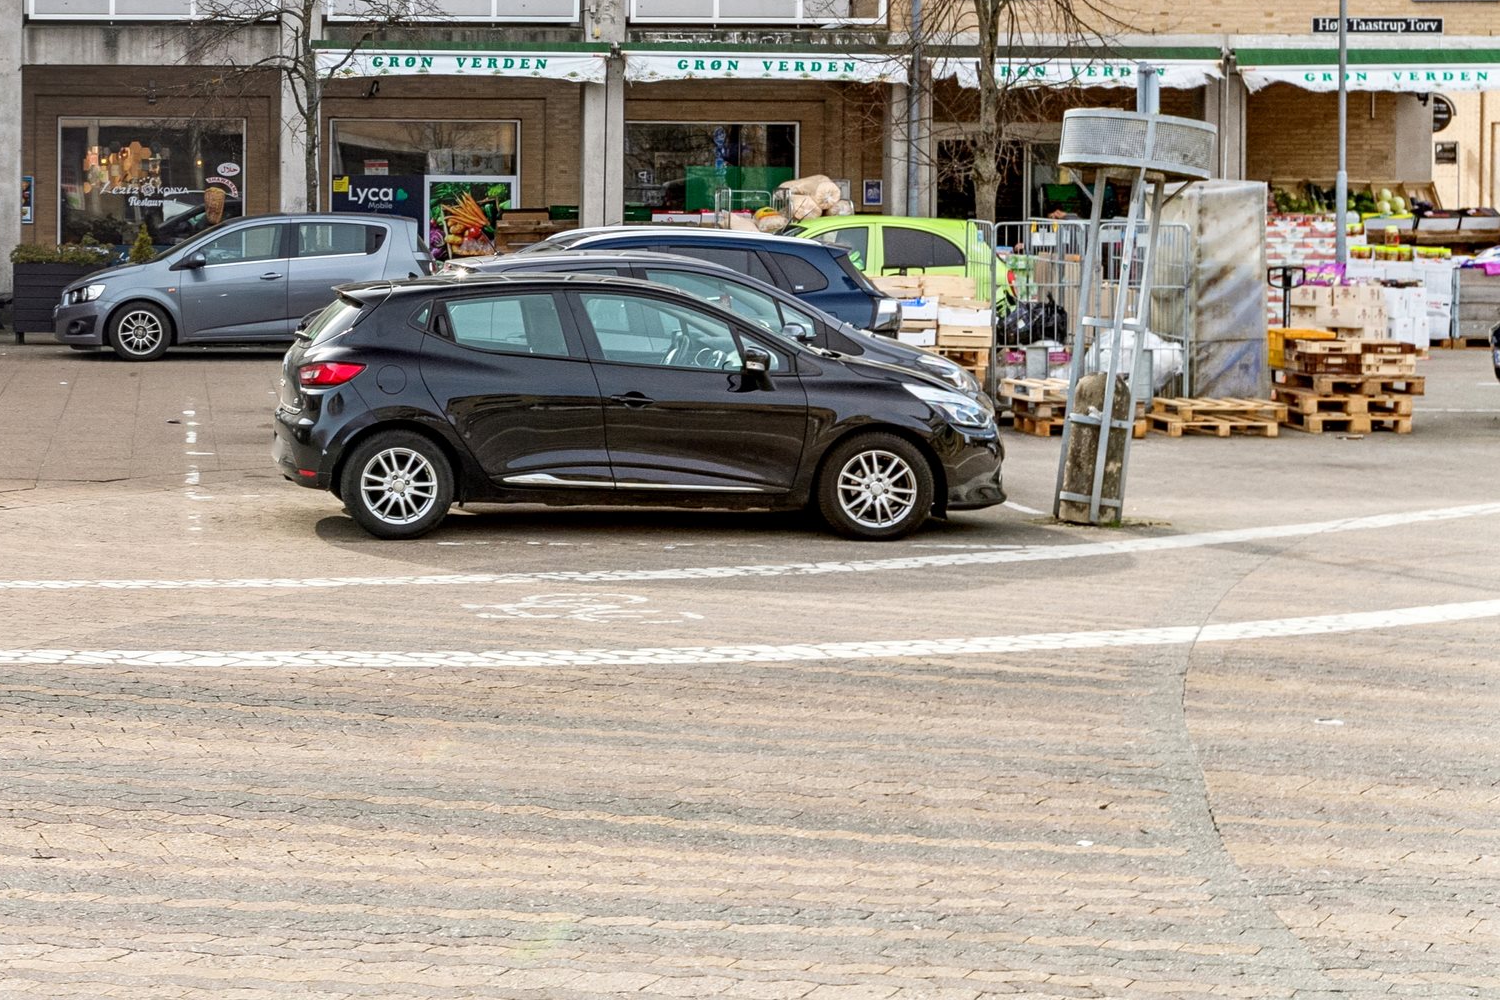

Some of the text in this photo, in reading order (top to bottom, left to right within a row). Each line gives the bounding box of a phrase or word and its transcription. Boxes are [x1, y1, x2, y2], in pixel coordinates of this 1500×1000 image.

[1350, 18, 1405, 33] Taastrup
[1407, 18, 1438, 31] Torv
[372, 56, 548, 70] GRØN VERDEN
[677, 59, 856, 73] GRØN VERDEN
[1071, 65, 1165, 77] VERDN
[1393, 71, 1488, 82] VERDEN
[157, 186, 189, 194] KONYA
[348, 184, 394, 205] Lyca
[367, 201, 393, 209] Mobile
